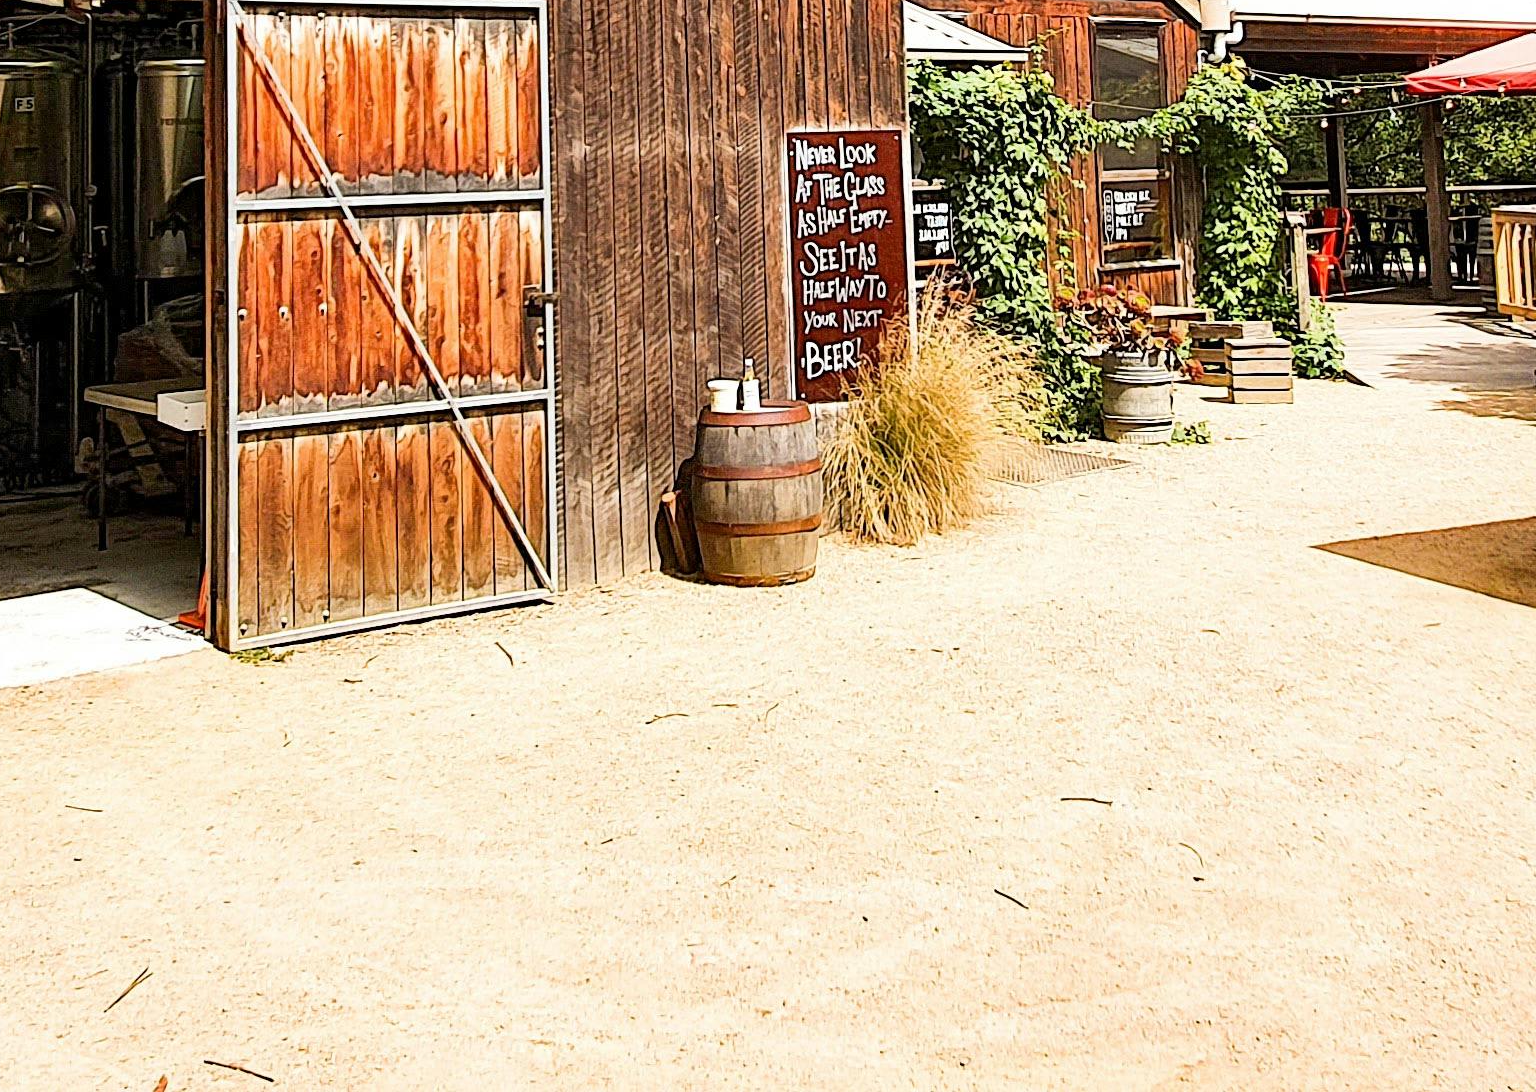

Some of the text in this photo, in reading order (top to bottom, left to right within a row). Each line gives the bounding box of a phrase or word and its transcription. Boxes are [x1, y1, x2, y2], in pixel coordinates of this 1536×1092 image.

[795, 137, 877, 171] NEVER LOOK
[795, 171, 886, 209] AT THE GLASS
[796, 208, 817, 239] AS
[816, 206, 847, 236] HALF
[799, 240, 877, 277] SEE IT AS
[863, 274, 887, 302] TO
[803, 308, 883, 335] YOUR NEXT
